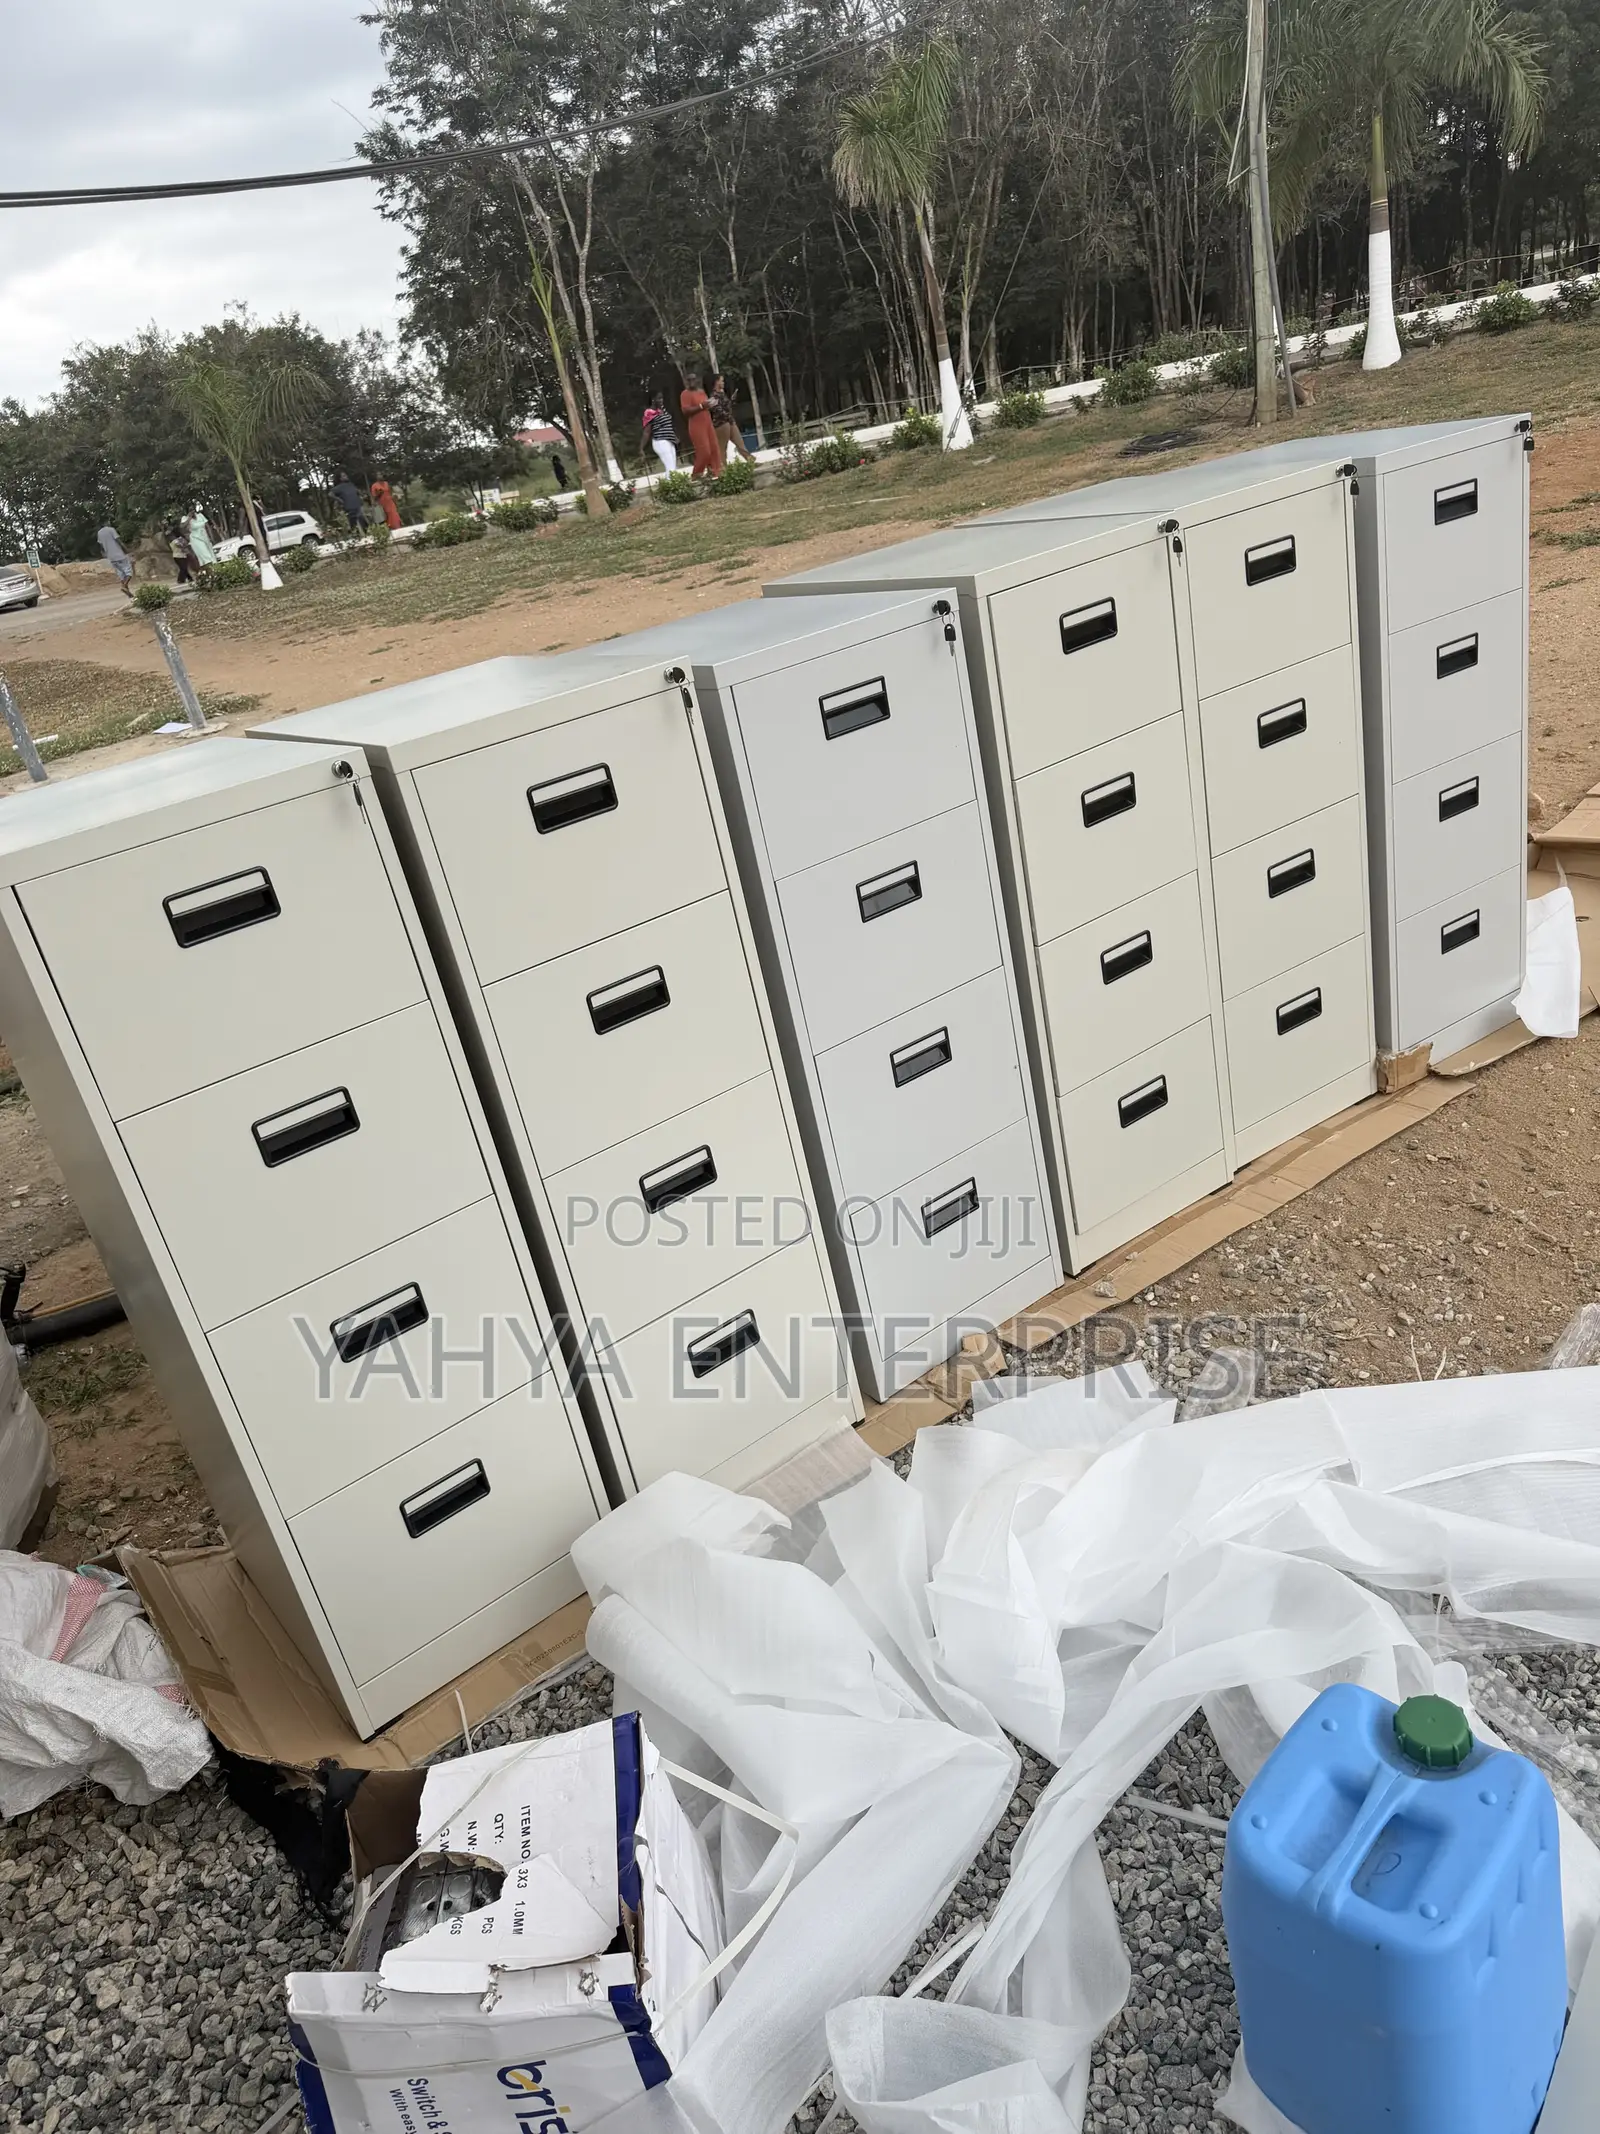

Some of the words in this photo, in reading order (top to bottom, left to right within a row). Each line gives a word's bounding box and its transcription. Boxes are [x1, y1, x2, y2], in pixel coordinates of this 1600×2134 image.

[493, 1812, 504, 1845] QTY:
[520, 1804, 531, 1838] ITEM
[467, 1820, 478, 1852] N.W:
[520, 1838, 531, 1864] NO.
[516, 1867, 528, 1889] 3X3
[449, 1916, 464, 1936] KGS
[481, 1916, 494, 1935] PCS
[512, 1900, 526, 1936] 1.0MM
[389, 2088, 409, 2112] With
[407, 2077, 443, 2119] Switch
[426, 2120, 449, 2130] &
